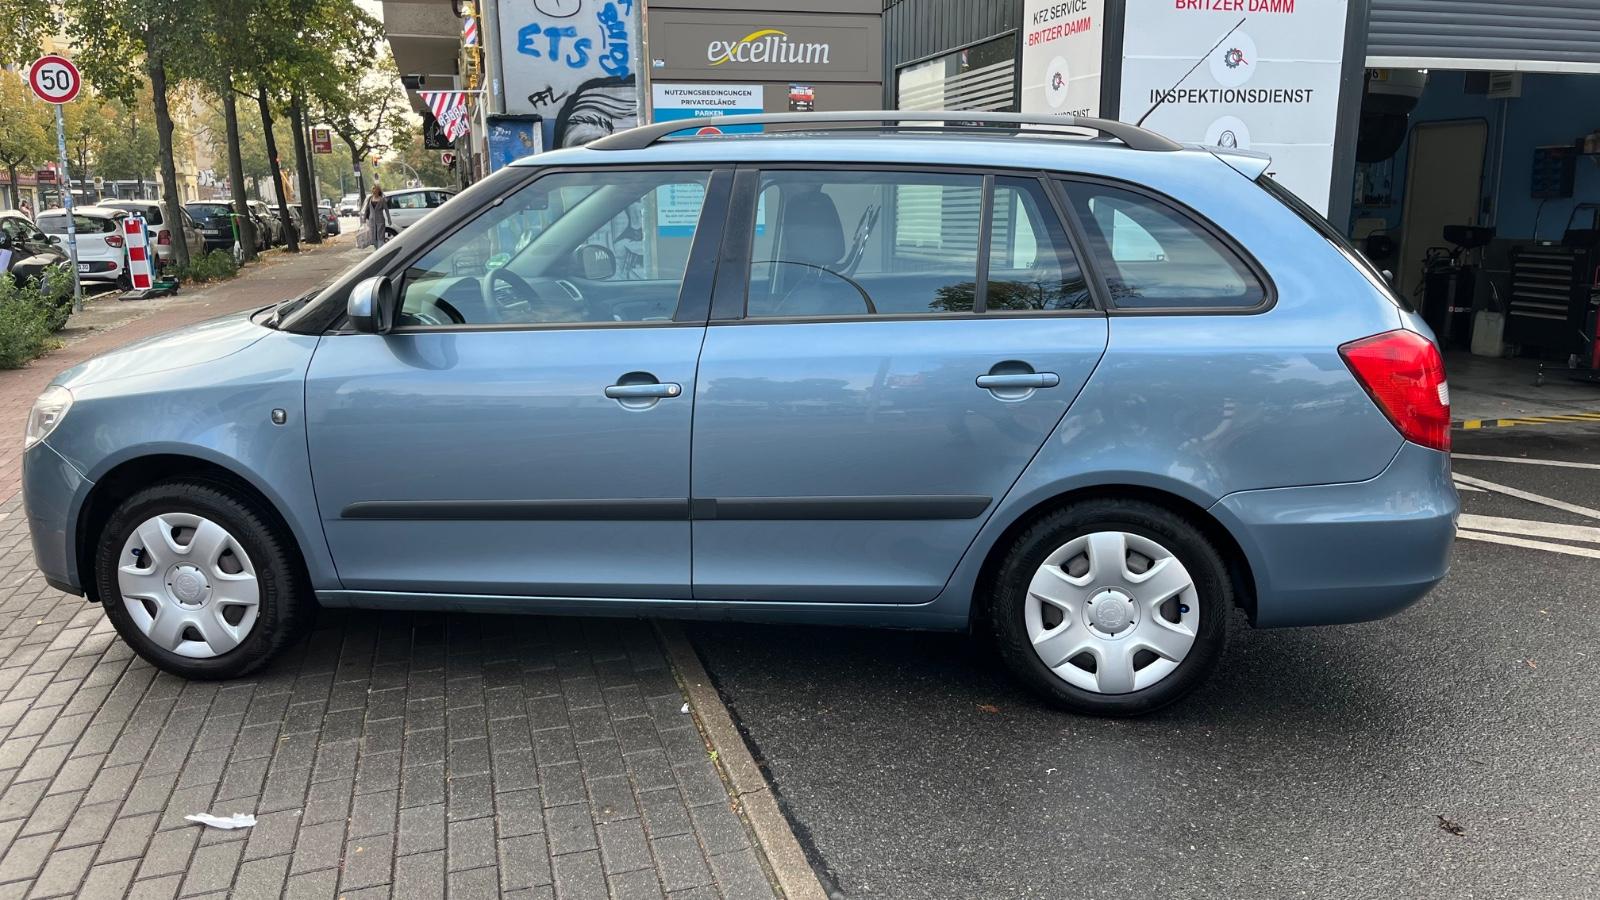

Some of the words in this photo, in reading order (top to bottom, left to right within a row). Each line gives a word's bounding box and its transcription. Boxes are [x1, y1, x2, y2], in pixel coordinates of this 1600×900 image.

[1033, 9, 1049, 25] KFZ
[1050, 0, 1087, 20] SERVICE
[1175, 0, 1244, 11] BRITZER
[1248, 0, 1295, 13] DAMM
[1028, 25, 1063, 46] BRITZER
[1064, 16, 1091, 37] DAMM
[707, 36, 830, 64] excellium
[41, 70, 70, 90] 50
[664, 89, 752, 97] NUTZUNGSBEDINGUNGEN
[1149, 89, 1313, 104] INSPEKTIONSDIENST
